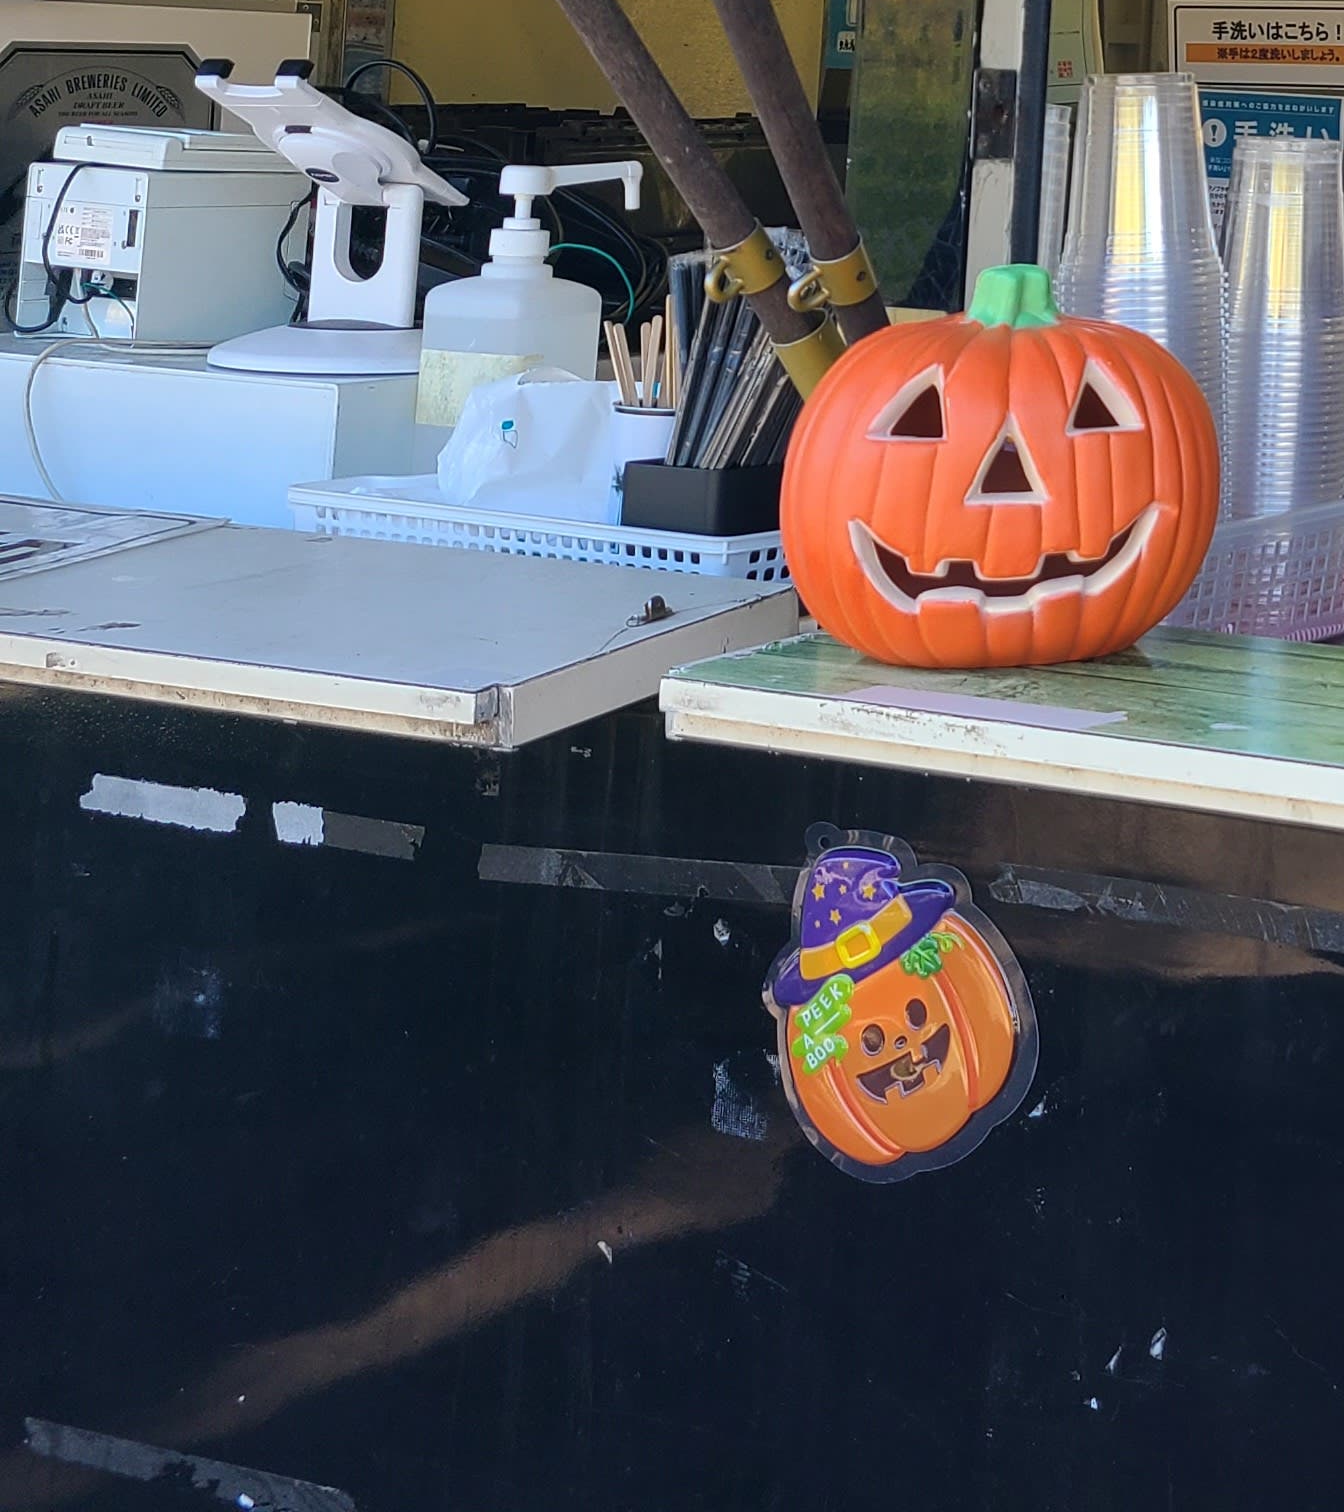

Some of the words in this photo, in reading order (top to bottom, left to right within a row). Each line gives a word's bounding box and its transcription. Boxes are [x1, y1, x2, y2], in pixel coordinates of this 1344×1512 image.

[1212, 19, 1342, 42] 手洗いはこちら！
[28, 85, 63, 118] ASAHI
[66, 72, 129, 95] BREWERIES
[130, 81, 169, 118] LIMITED
